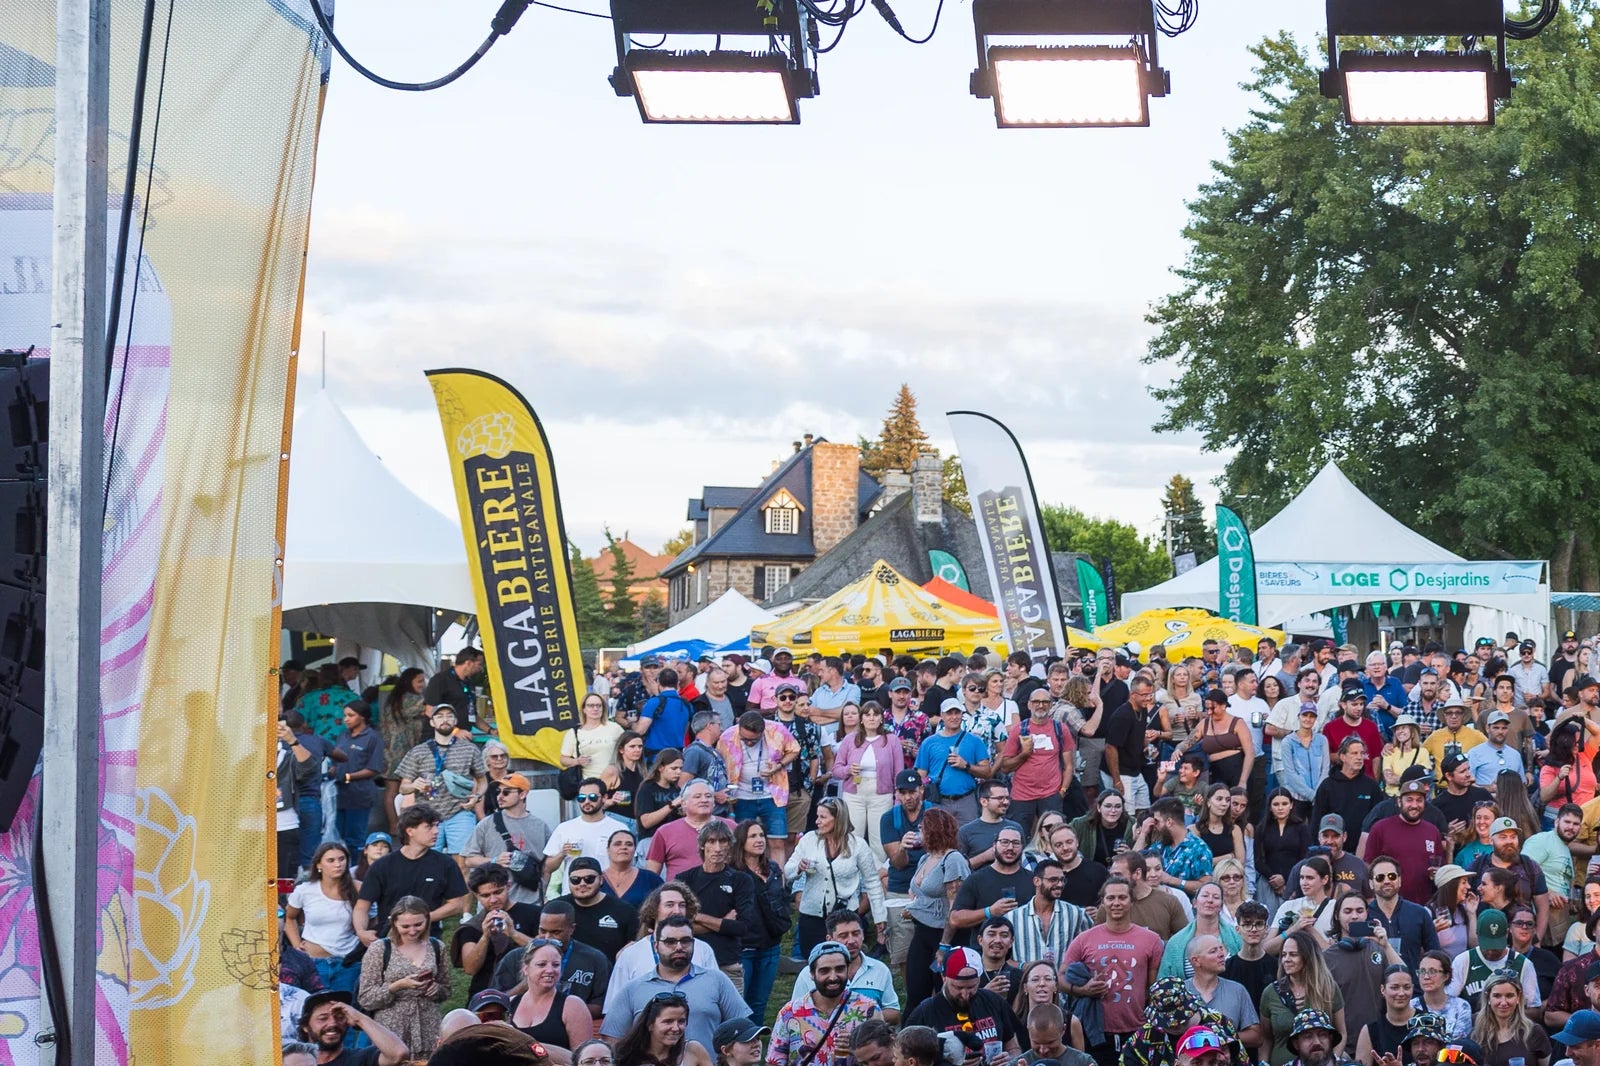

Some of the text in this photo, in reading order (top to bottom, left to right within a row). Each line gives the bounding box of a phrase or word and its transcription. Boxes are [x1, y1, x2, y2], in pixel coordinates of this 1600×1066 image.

[1259, 570, 1288, 579] BIÈRES
[1330, 572, 1380, 587] LOGE
[1414, 570, 1490, 590] Desjardins
[476, 465, 554, 725] LAGABIÈRE
[516, 462, 572, 721] BRASSERIE ARTISANALE
[891, 629, 944, 639] LAGABIÈRE
